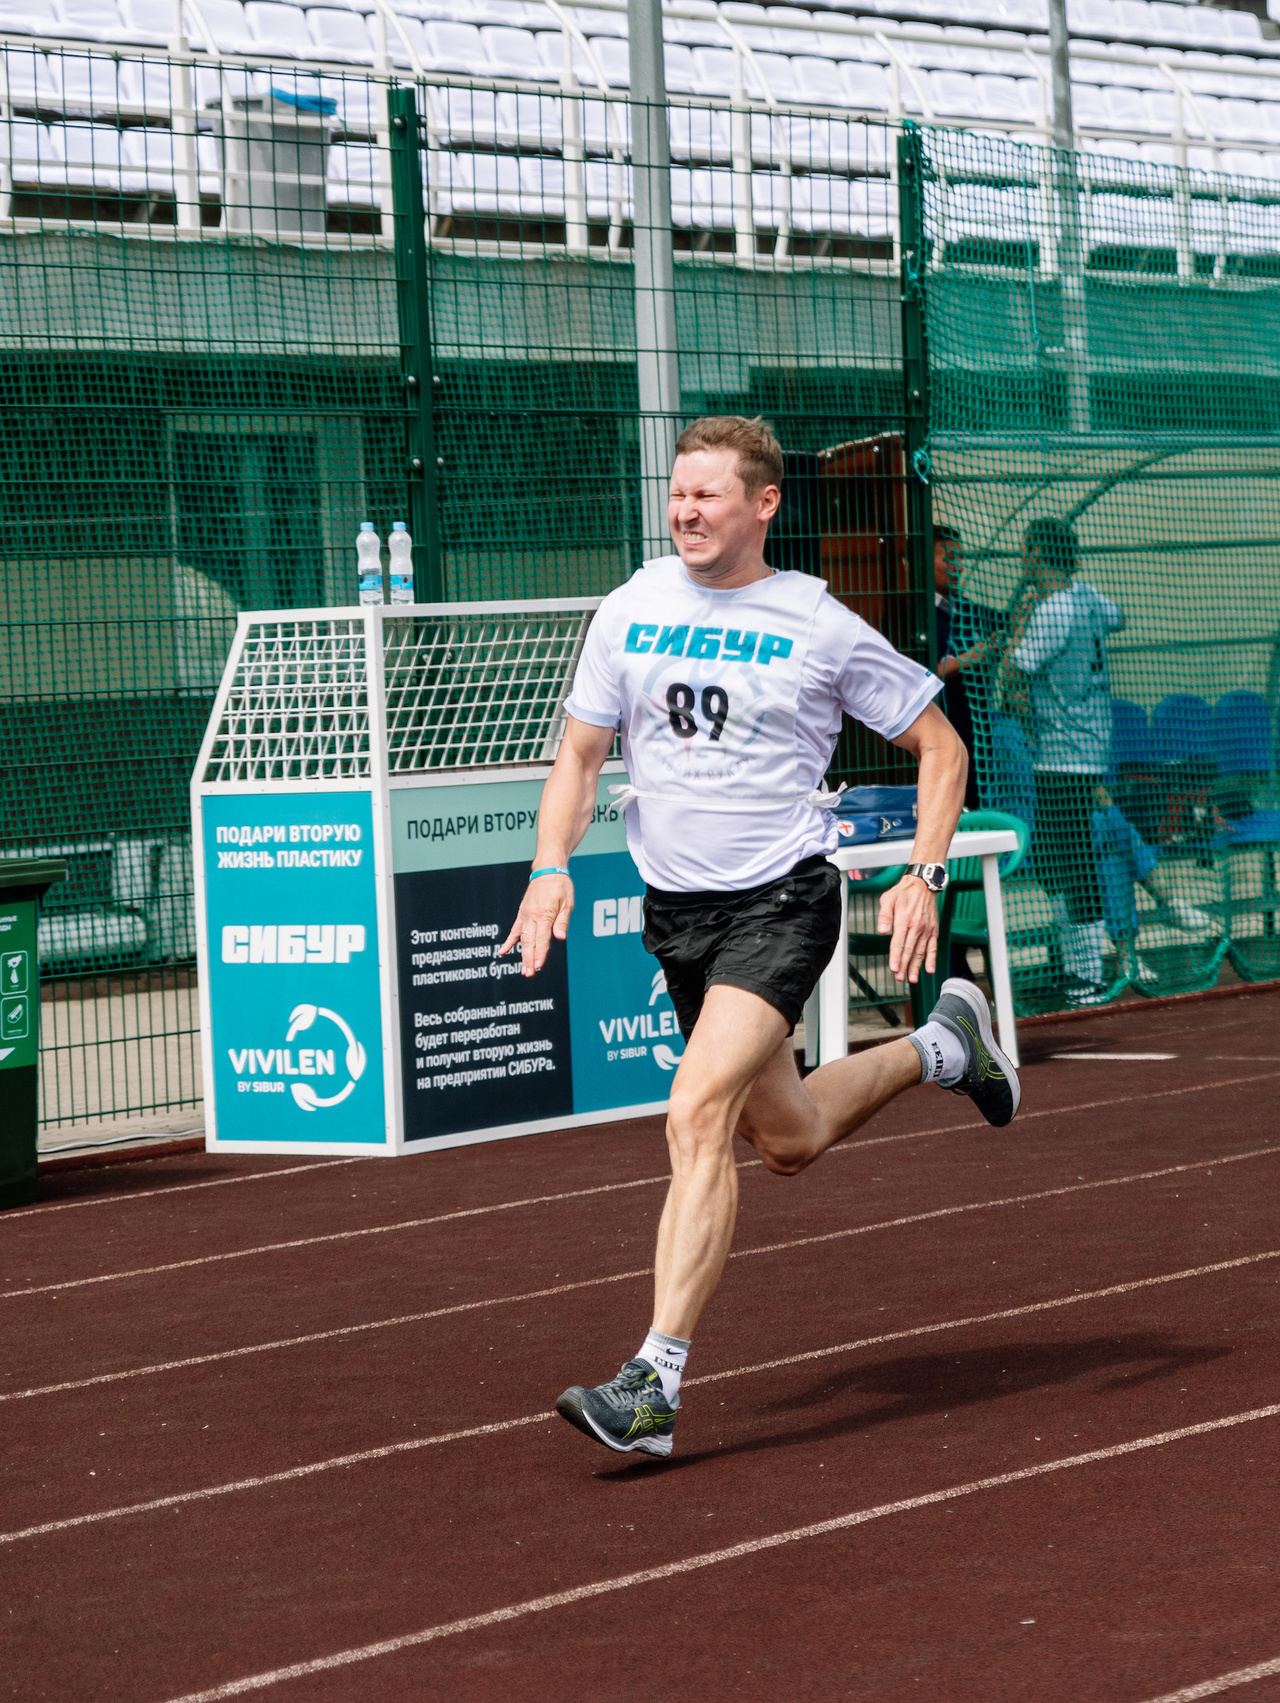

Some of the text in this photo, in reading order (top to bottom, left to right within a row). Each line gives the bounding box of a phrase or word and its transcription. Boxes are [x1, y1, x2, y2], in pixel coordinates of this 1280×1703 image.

[623, 622, 794, 666] СИБУР
[665, 683, 730, 742] 89
[216, 824, 362, 847] ПОДАРИ ВТОРУЮ
[407, 815, 480, 842] ПОДАРИ
[484, 810, 538, 833] ВТОРУ
[217, 849, 363, 869] ЖИЗНЬ ПЛАСТИКУ
[221, 924, 366, 964] СИБУР
[410, 922, 499, 945] Этот контейнер
[411, 944, 491, 969] предназначен
[412, 966, 488, 987] пластиковых
[414, 998, 554, 1028] Весь собранный пластик
[599, 1010, 681, 1044] VIVILE
[415, 1022, 521, 1051] будет переработан
[228, 1048, 335, 1076] VIVILEN
[416, 1039, 553, 1069] и получит вторую жизнь
[607, 1046, 648, 1061] BY SIBUR
[237, 1081, 285, 1093] BY SIBUR
[416, 1056, 556, 1091] на предприятии СИБУРа.
